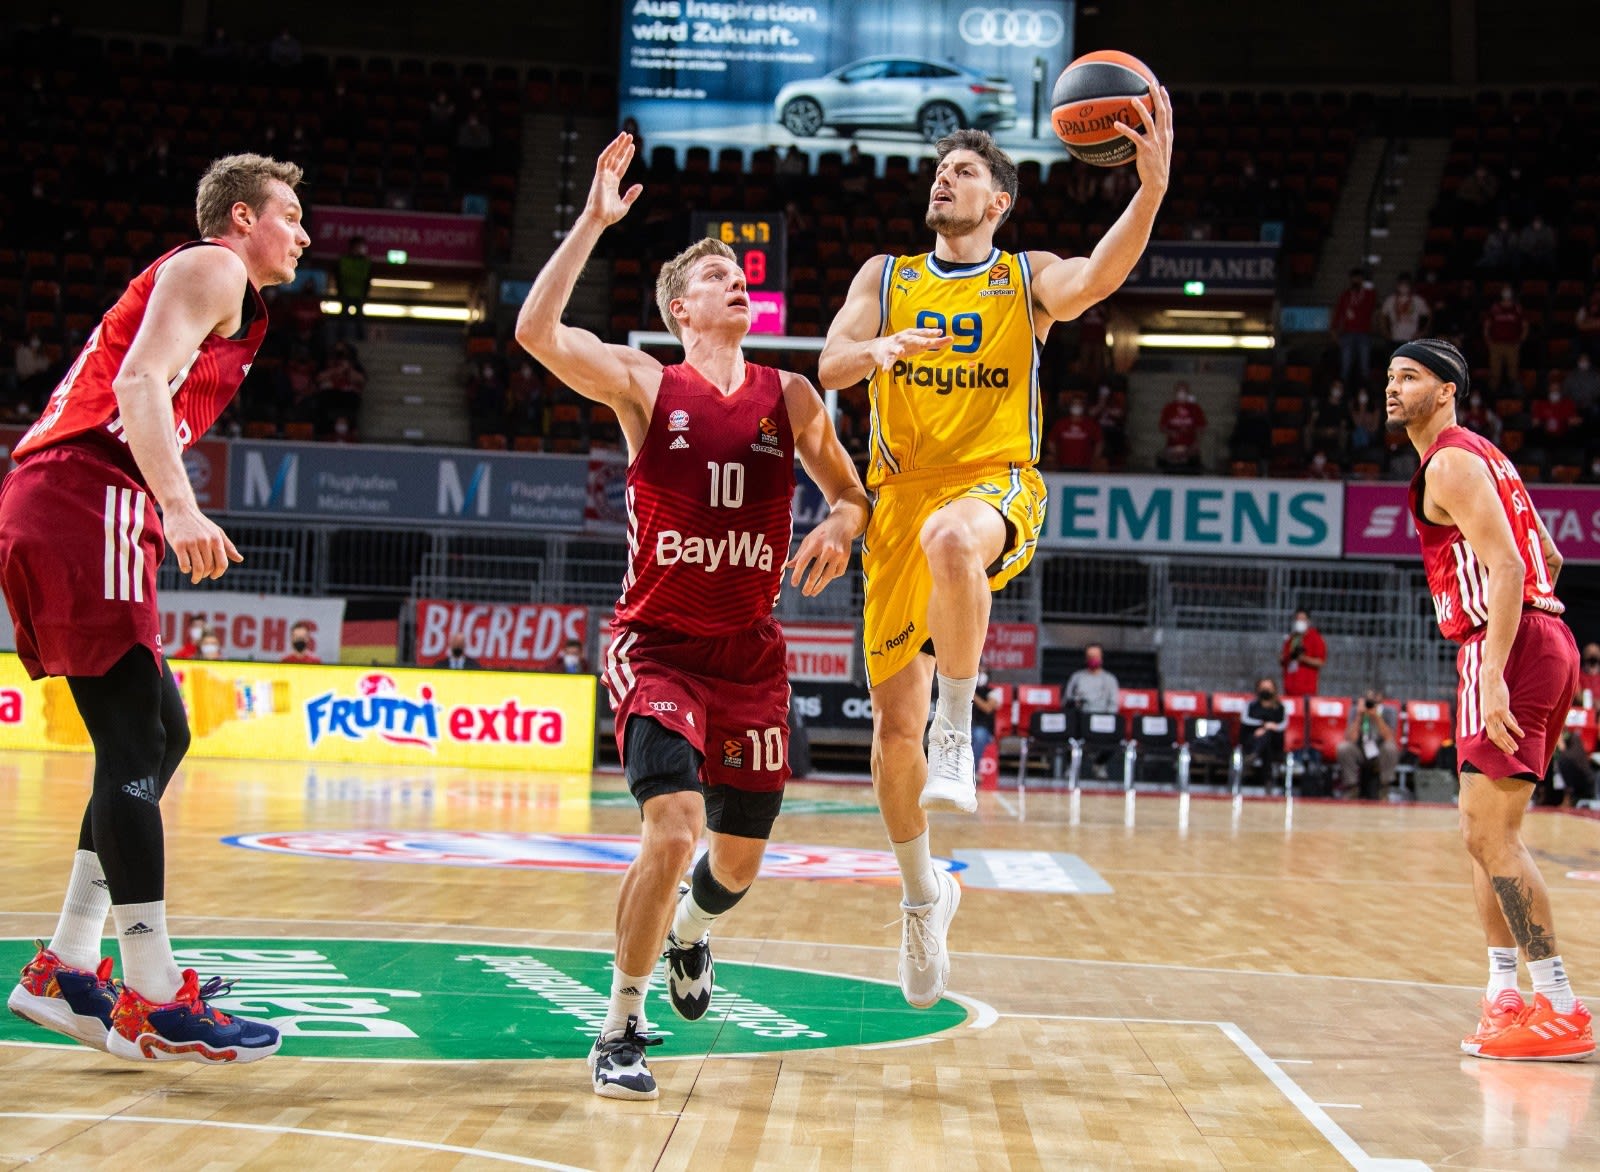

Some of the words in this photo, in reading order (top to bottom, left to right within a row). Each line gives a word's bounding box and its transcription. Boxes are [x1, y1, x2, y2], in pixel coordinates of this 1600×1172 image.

[632, 0, 681, 17] Aus
[686, 1, 818, 22] Inspiration
[632, 21, 688, 42] wird
[692, 22, 800, 47] Zukunft.
[1057, 107, 1130, 136] SPALDING
[338, 223, 420, 244] MAGENTA
[425, 229, 477, 246] SPORT
[744, 250, 766, 285] 8
[1150, 255, 1275, 279] PAULANER
[893, 360, 1009, 395] Playtika
[318, 471, 398, 493] Flughafen
[707, 461, 745, 509] 10
[656, 530, 774, 573] BayWa
[886, 621, 915, 652] Rapyd
[450, 701, 563, 744] extra
[746, 727, 784, 771] 10
[124, 928, 154, 936] adidas
